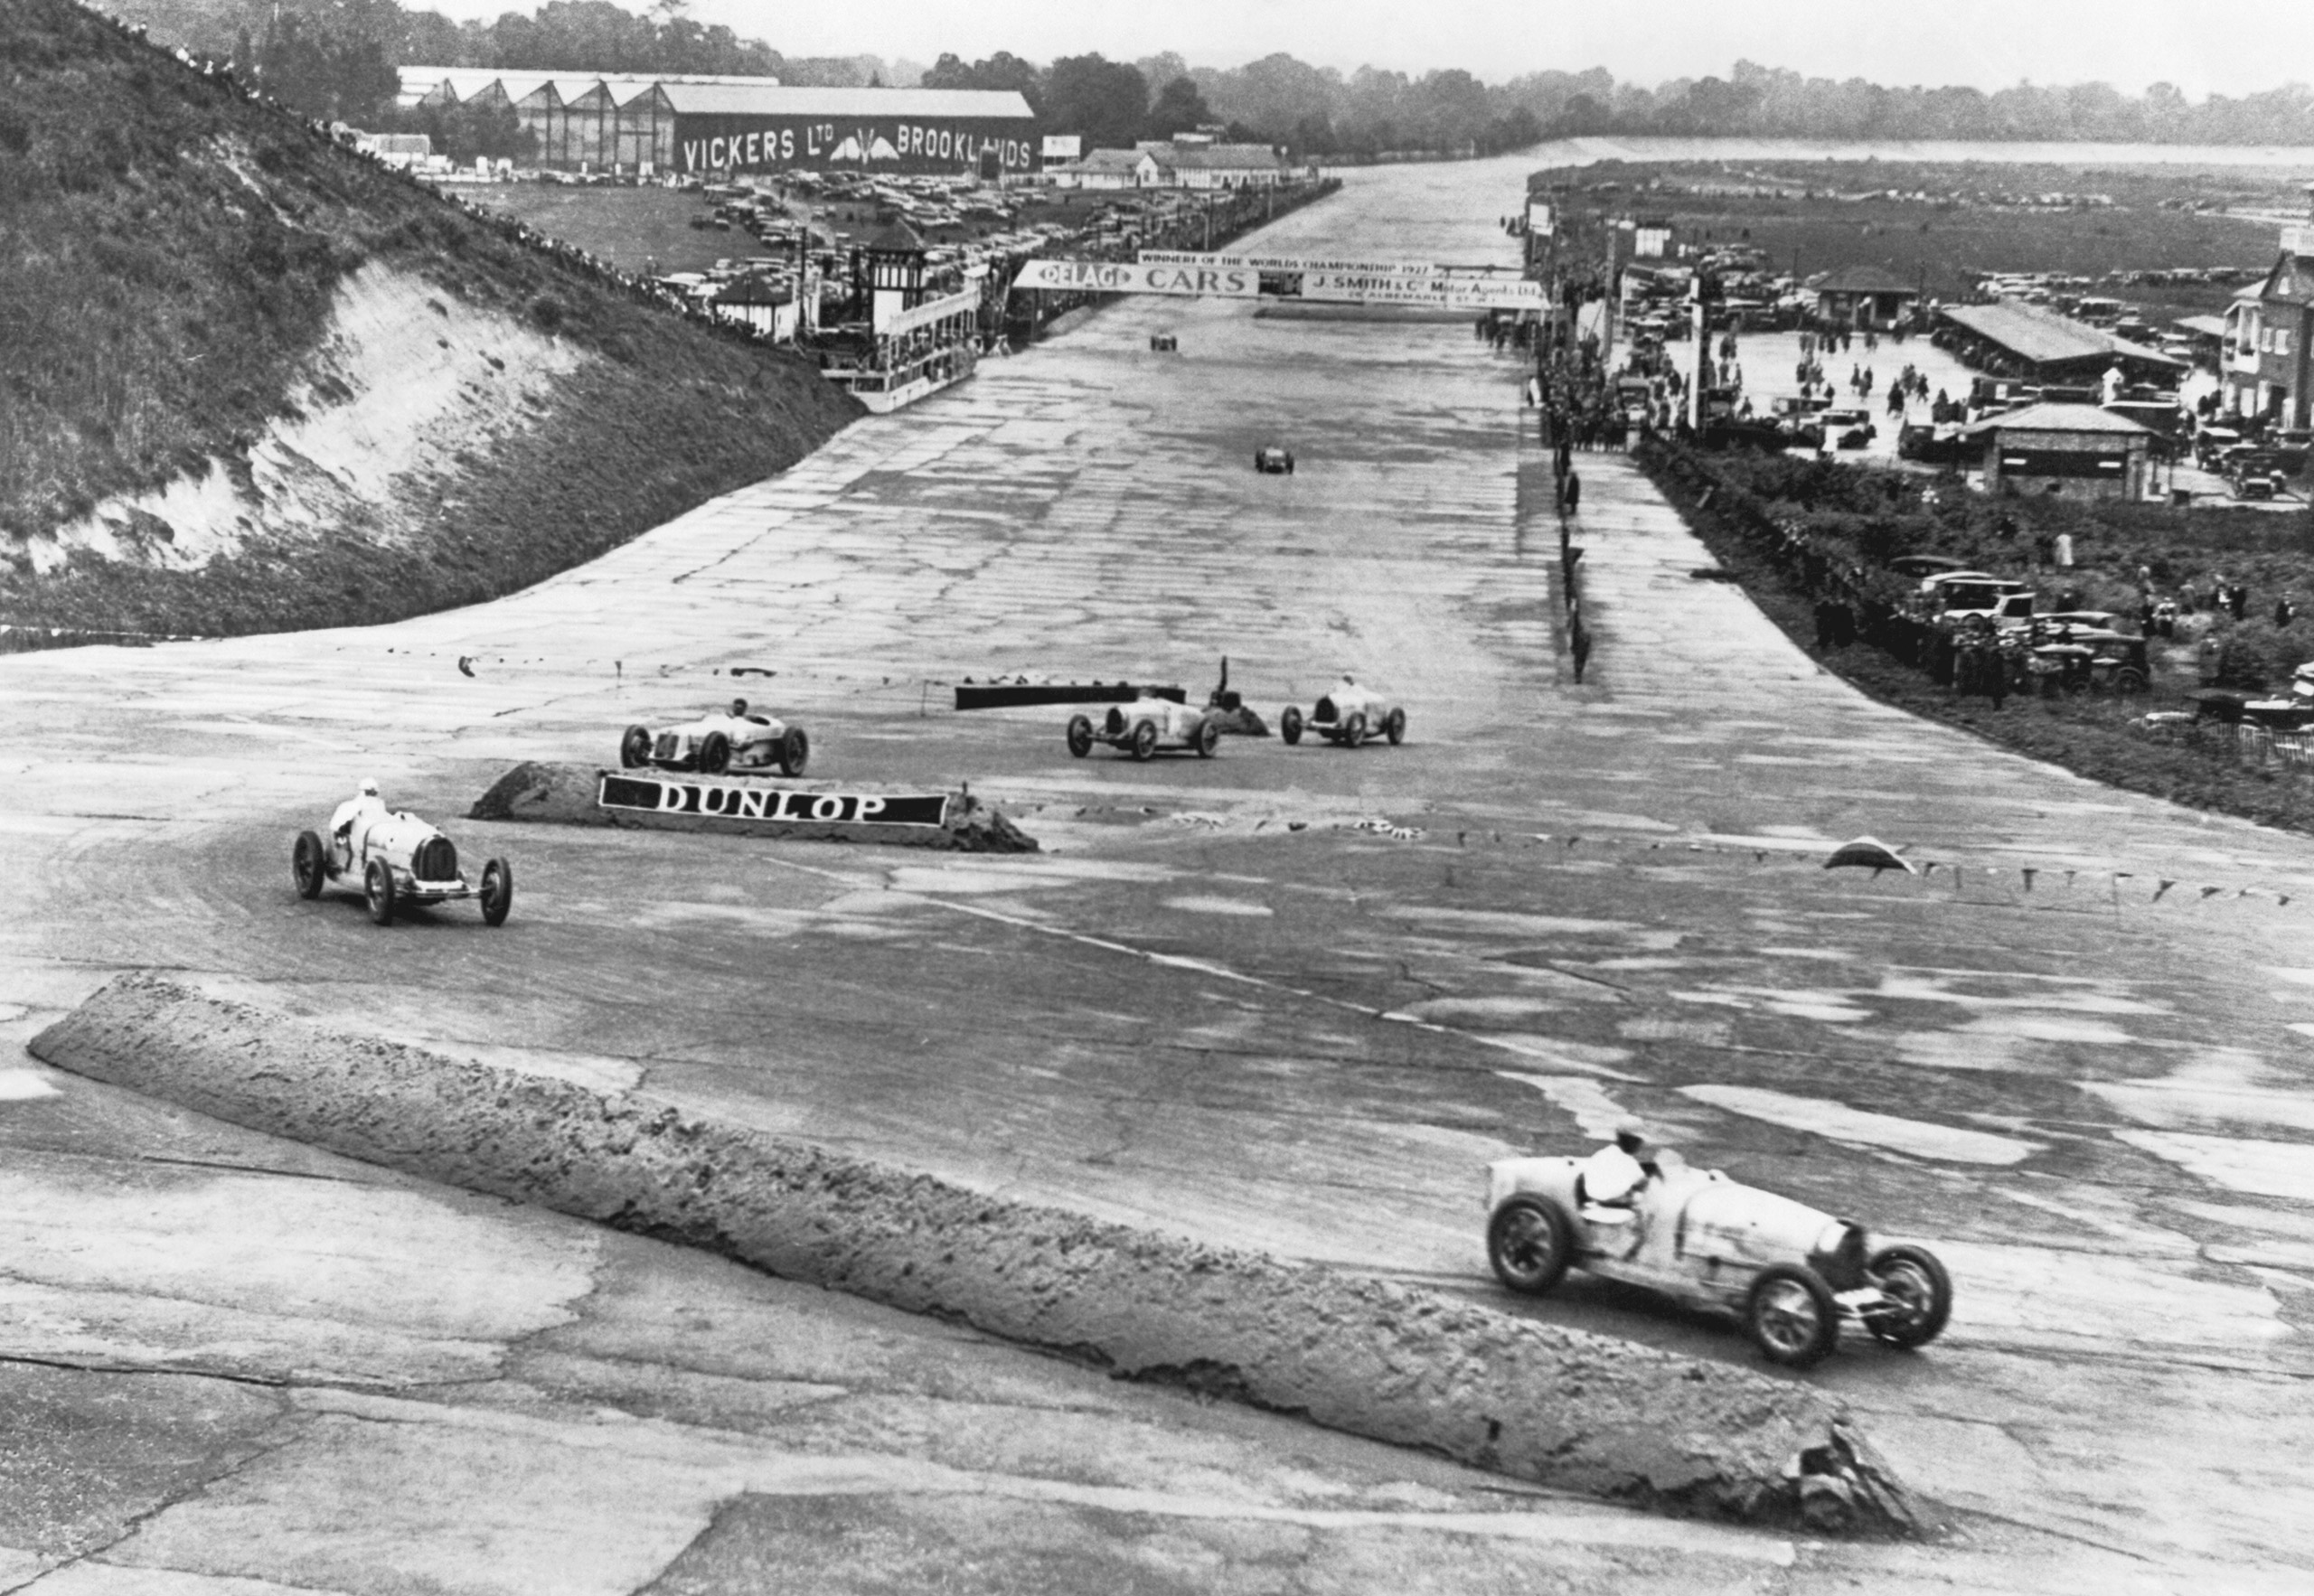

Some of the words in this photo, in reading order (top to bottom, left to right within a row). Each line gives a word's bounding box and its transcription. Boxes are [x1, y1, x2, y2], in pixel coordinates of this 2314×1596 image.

[684, 129, 794, 171] VICKERS
[1146, 269, 1245, 292] CARS
[1334, 277, 1391, 290] SMITH
[657, 783, 887, 822] DUNLOP
